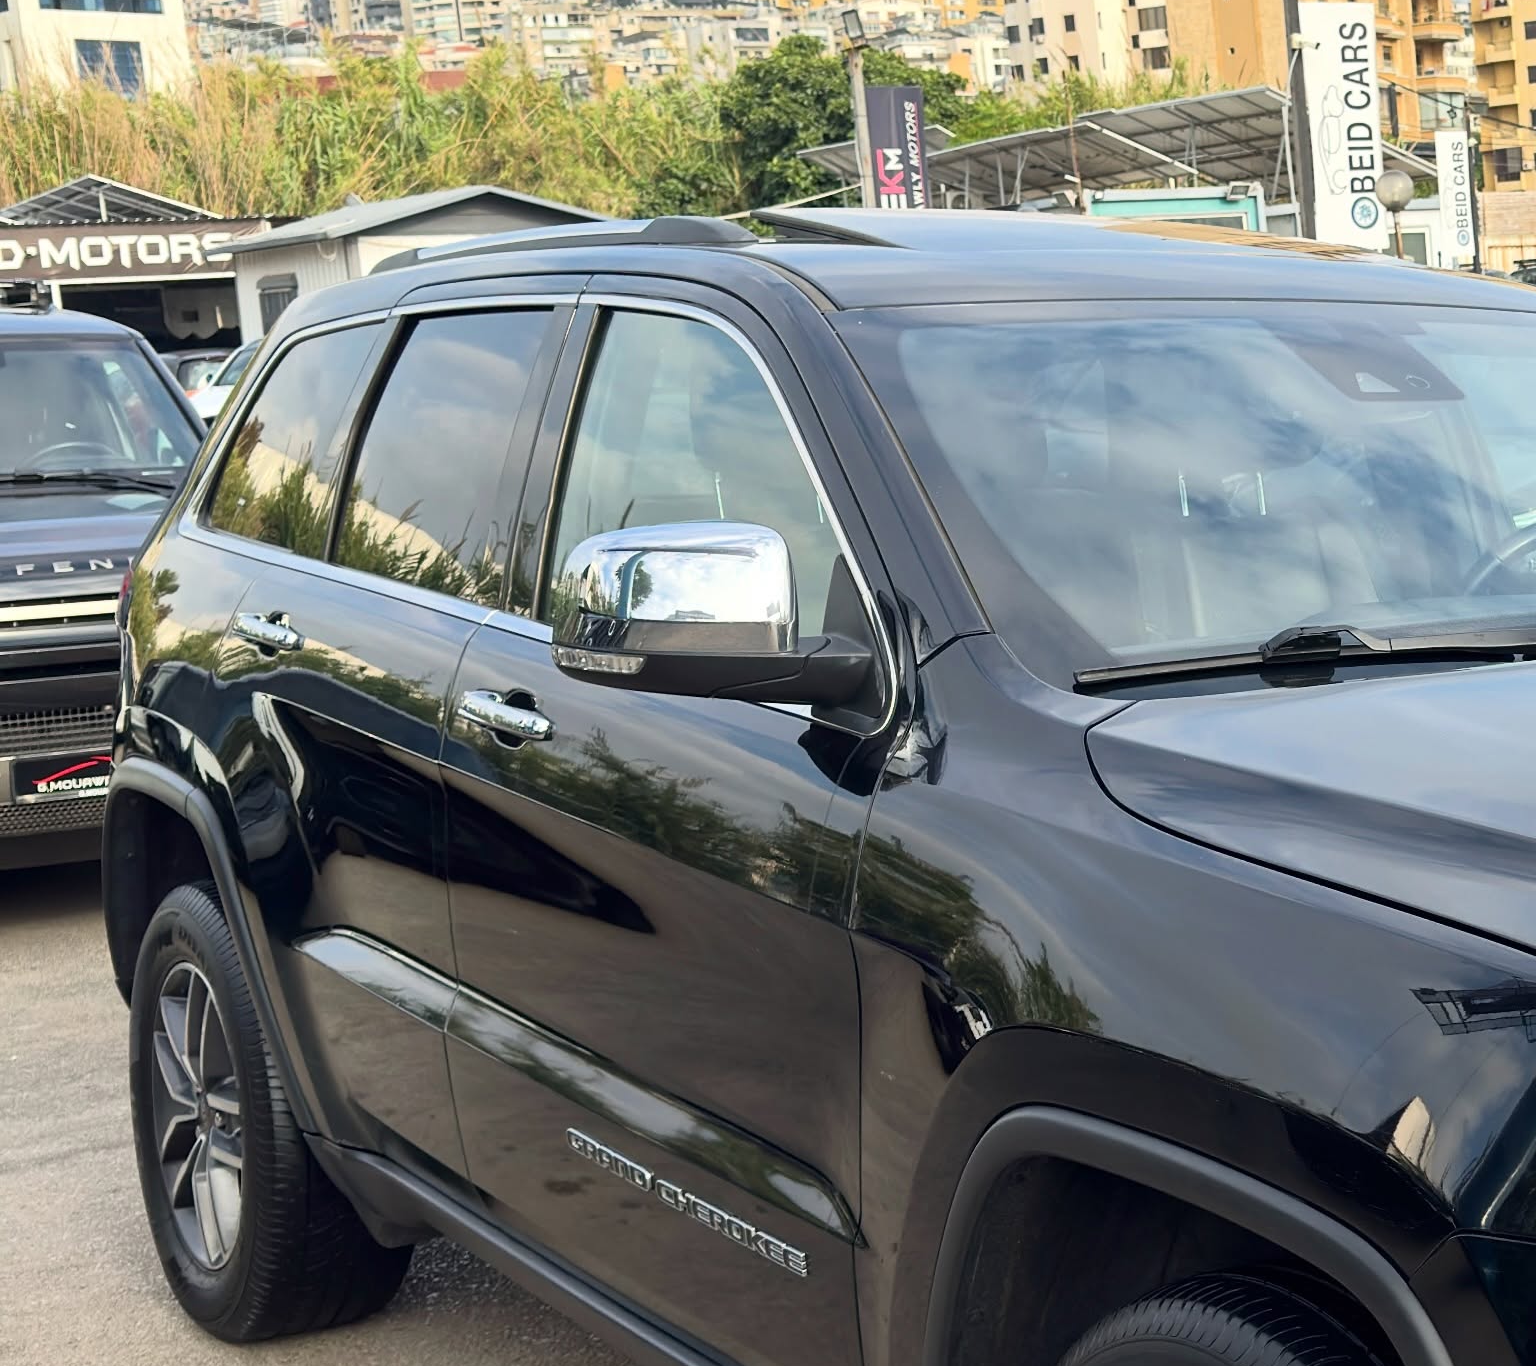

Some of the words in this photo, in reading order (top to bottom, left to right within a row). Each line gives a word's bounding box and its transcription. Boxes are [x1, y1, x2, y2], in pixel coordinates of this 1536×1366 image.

[1339, 22, 1371, 110] CARS
[904, 101, 920, 167] MOTORS
[1451, 141, 1465, 186] CARS
[566, 1128, 654, 1191] GRAND
[655, 1179, 808, 1277] CHEROKEE
